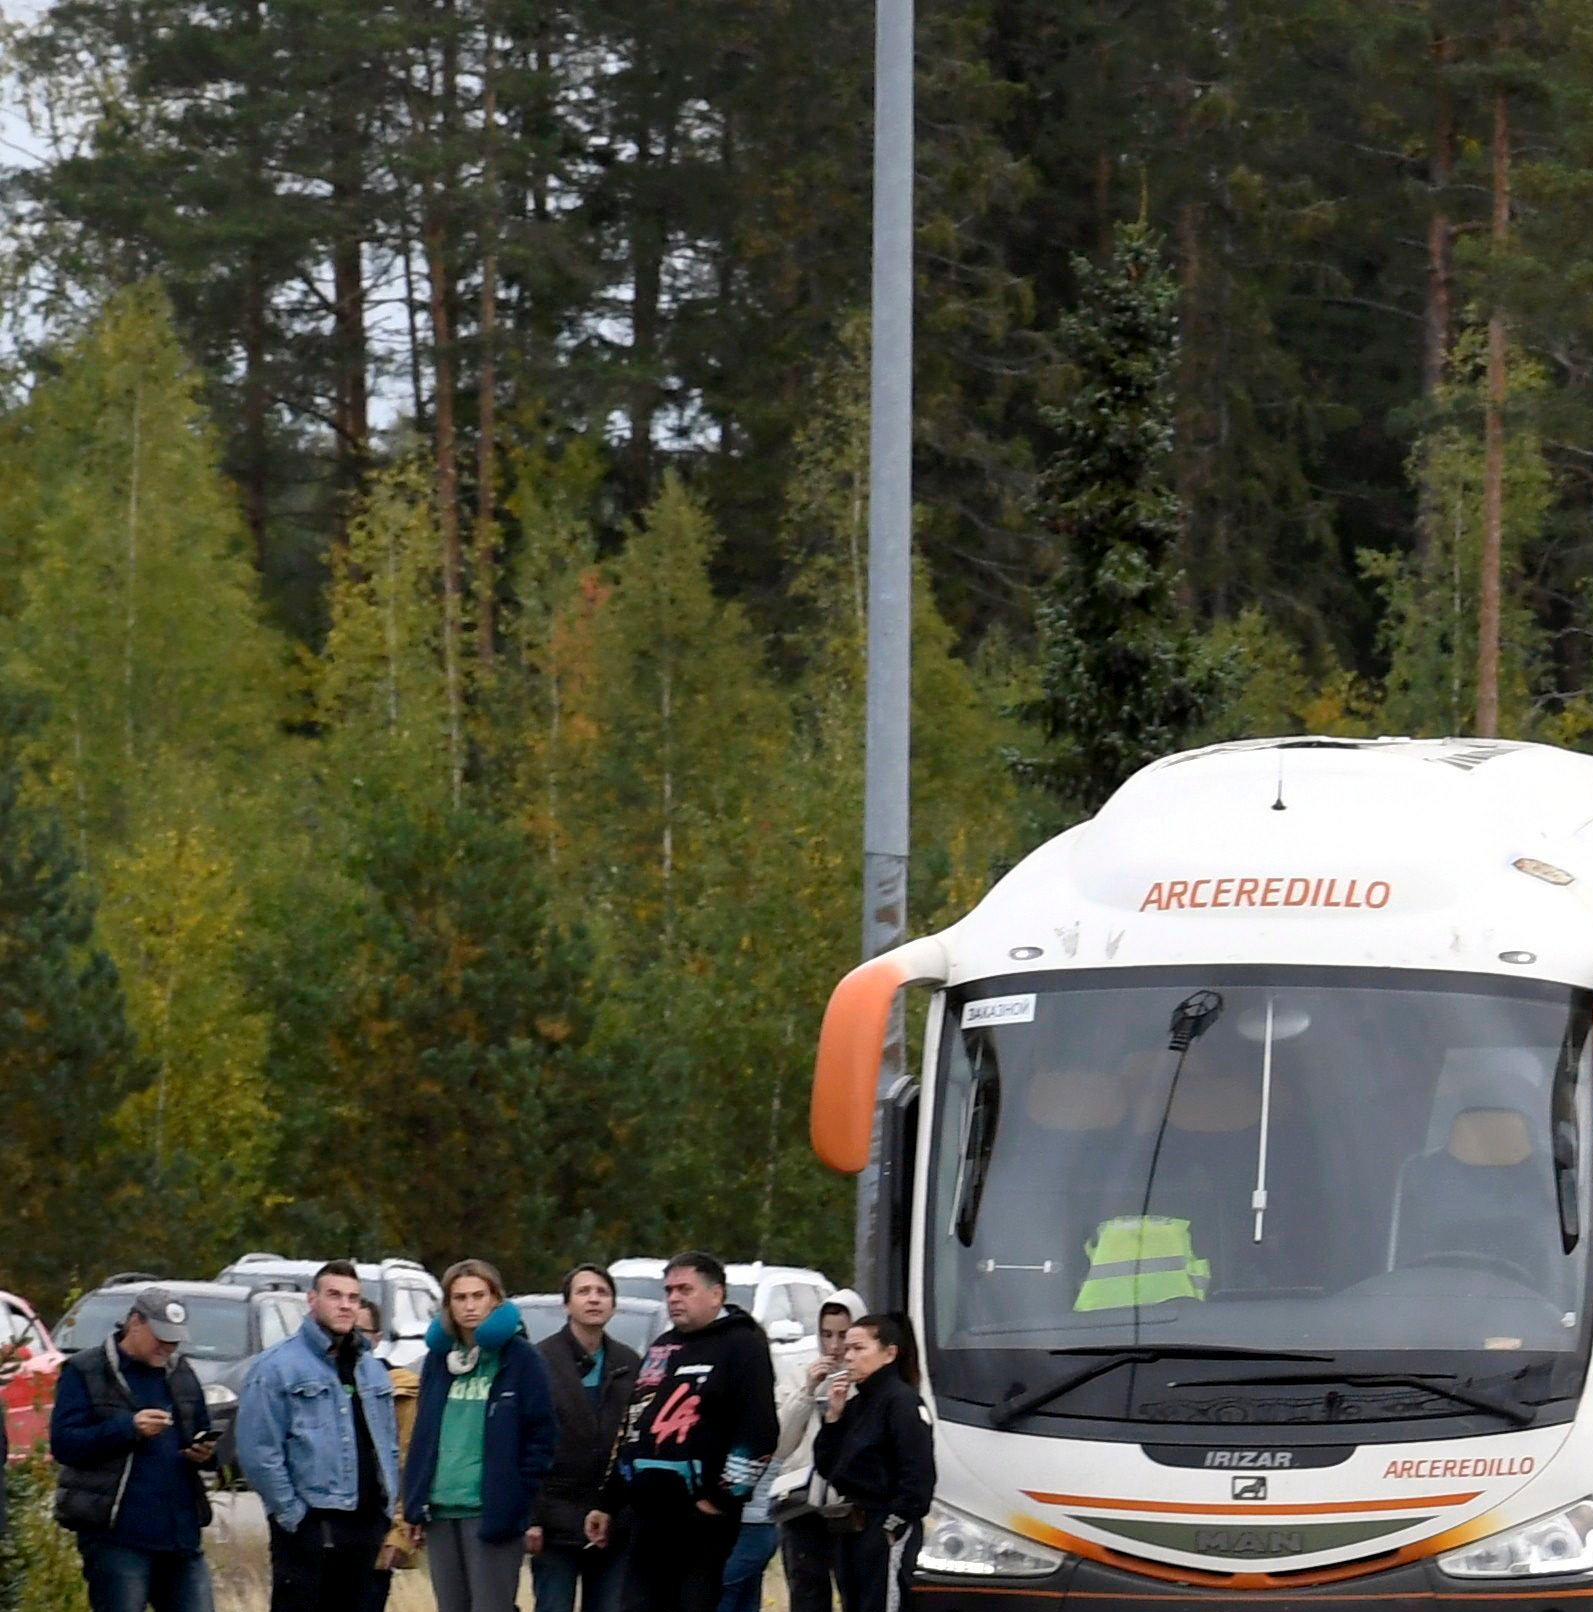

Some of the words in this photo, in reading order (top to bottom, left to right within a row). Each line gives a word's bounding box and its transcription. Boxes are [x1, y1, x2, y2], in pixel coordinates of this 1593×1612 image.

[1138, 877, 1393, 913] ARCEREDILLO
[1203, 1450, 1294, 1468] IRIZAR
[1383, 1456, 1535, 1479] ARCEREDILLO
[1195, 1531, 1303, 1553] MAN
